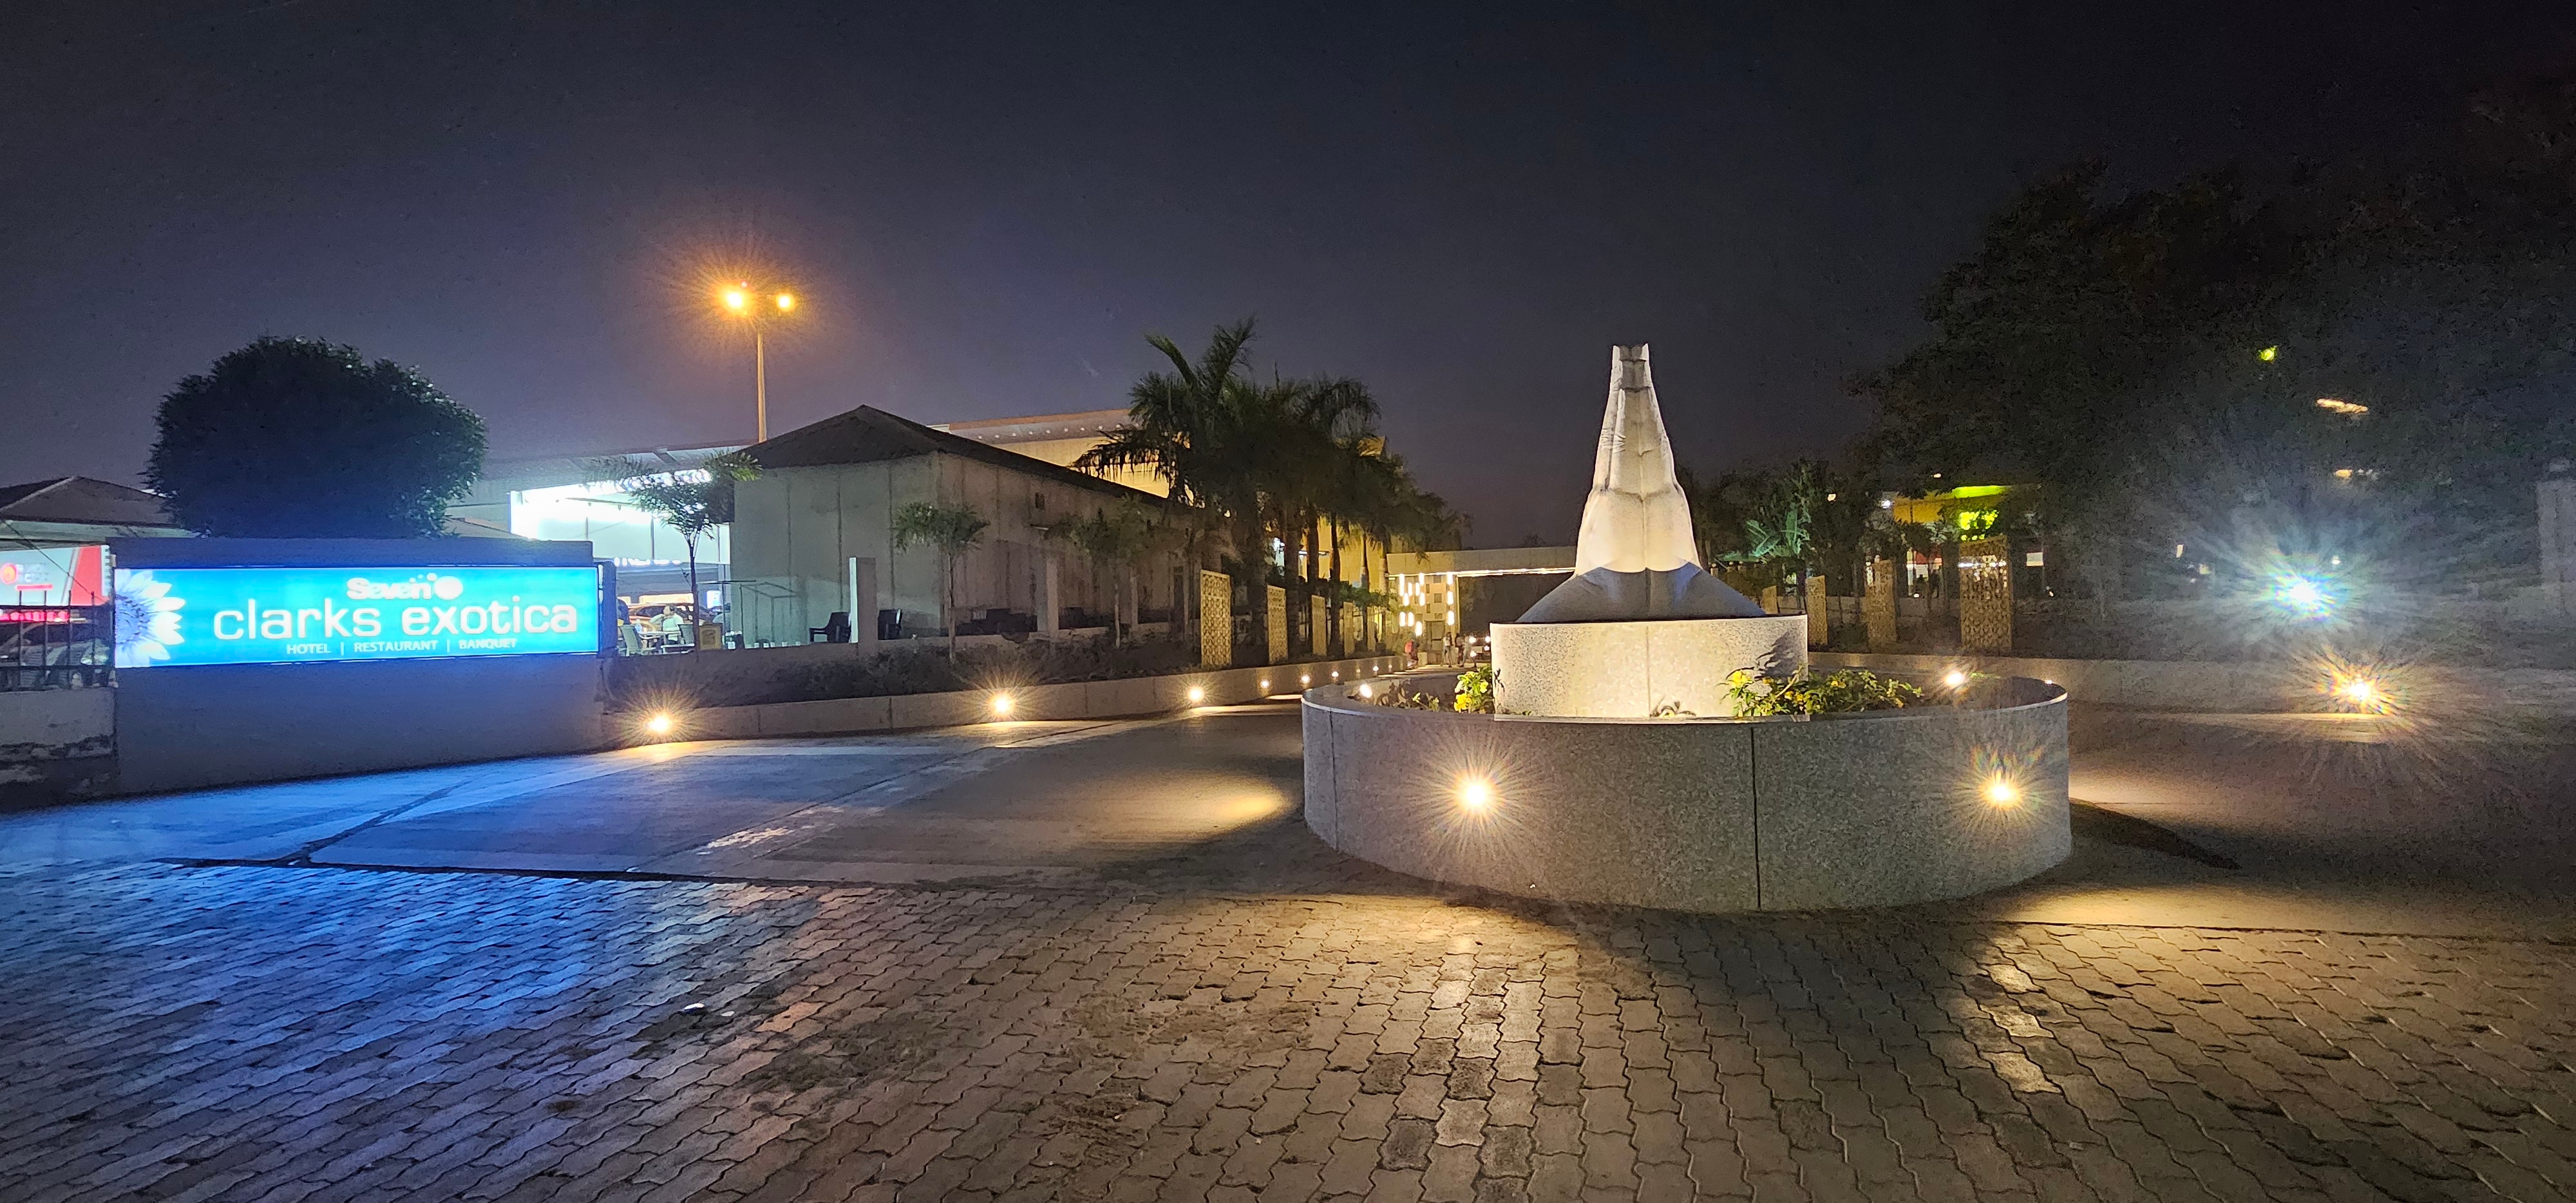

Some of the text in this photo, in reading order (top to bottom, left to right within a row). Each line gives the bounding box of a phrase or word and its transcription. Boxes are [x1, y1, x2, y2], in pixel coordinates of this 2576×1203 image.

[214, 594, 577, 639] clarks exotica
[287, 638, 517, 654] HOTEL RESTAURANT BANQUET
